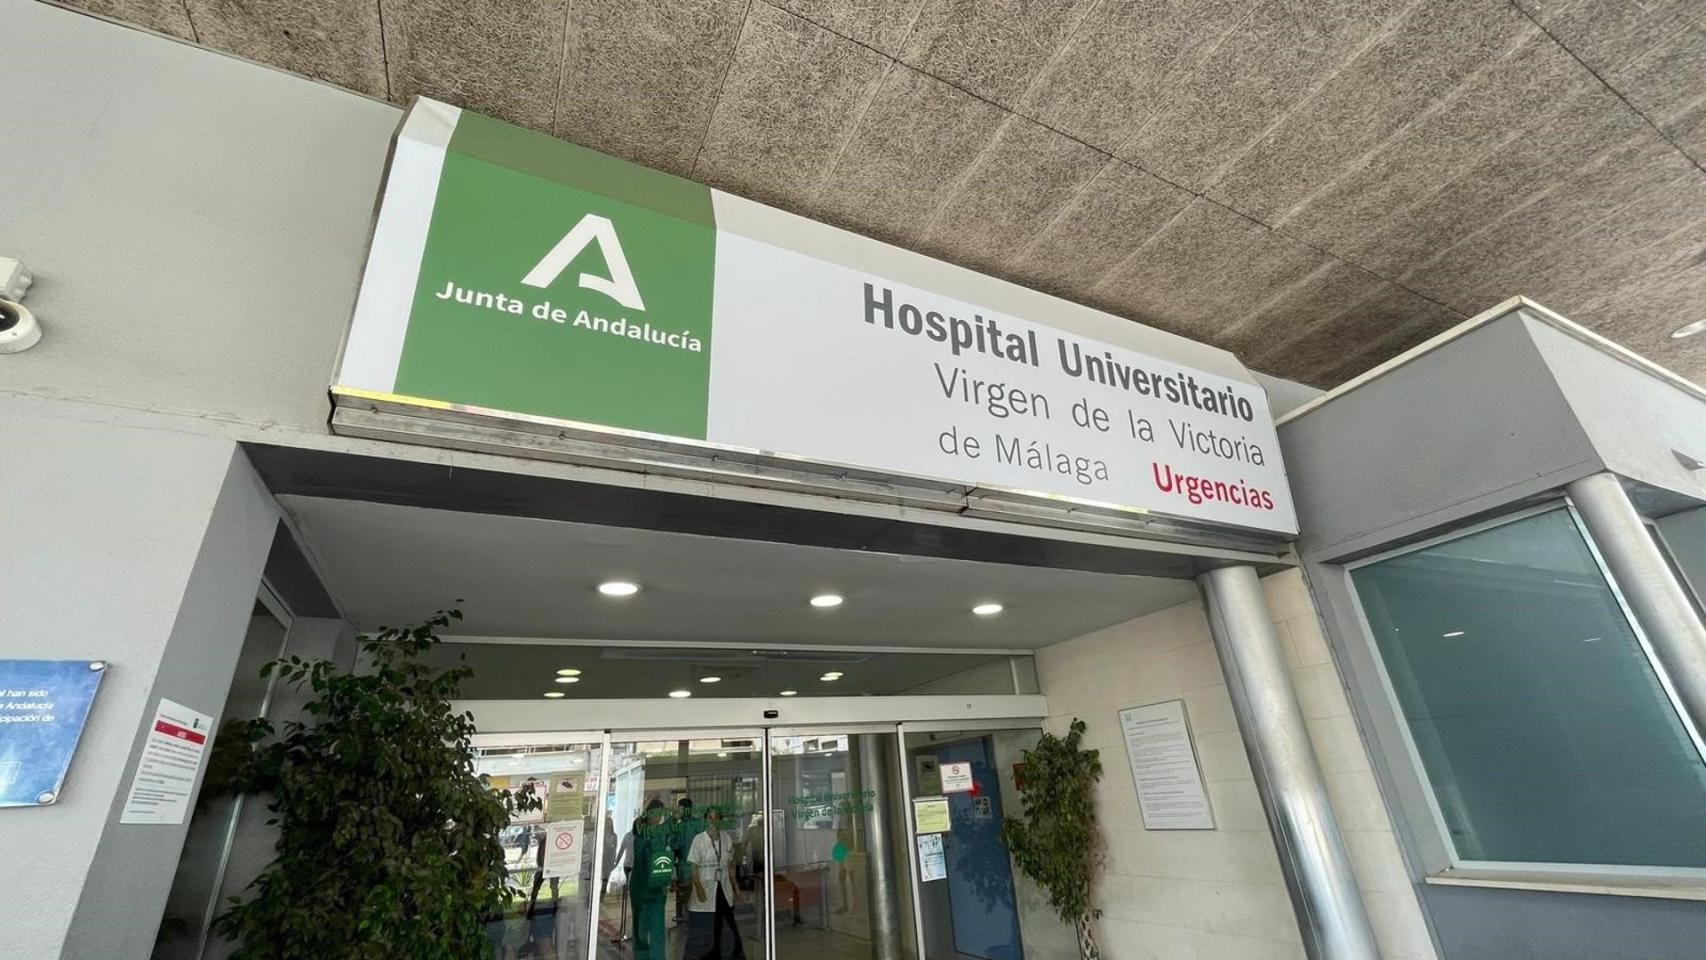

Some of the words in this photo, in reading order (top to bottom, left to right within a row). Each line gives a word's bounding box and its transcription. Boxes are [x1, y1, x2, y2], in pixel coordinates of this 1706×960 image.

[435, 281, 524, 314] Junta
[531, 301, 567, 323] de
[572, 310, 702, 352] Andalucía
[863, 282, 1040, 367] Hospital
[1057, 337, 1254, 422] Universitario
[934, 362, 1050, 419] Virgen
[1071, 397, 1110, 433] de
[1128, 408, 1154, 443] la
[1168, 418, 1265, 466] Victoria
[938, 425, 981, 458] de
[995, 433, 1108, 485] Málaga
[1151, 461, 1274, 511] Urgencias
[6, 689, 26, 697] han
[27, 689, 49, 697] sido
[41, 714, 56, 722] de
